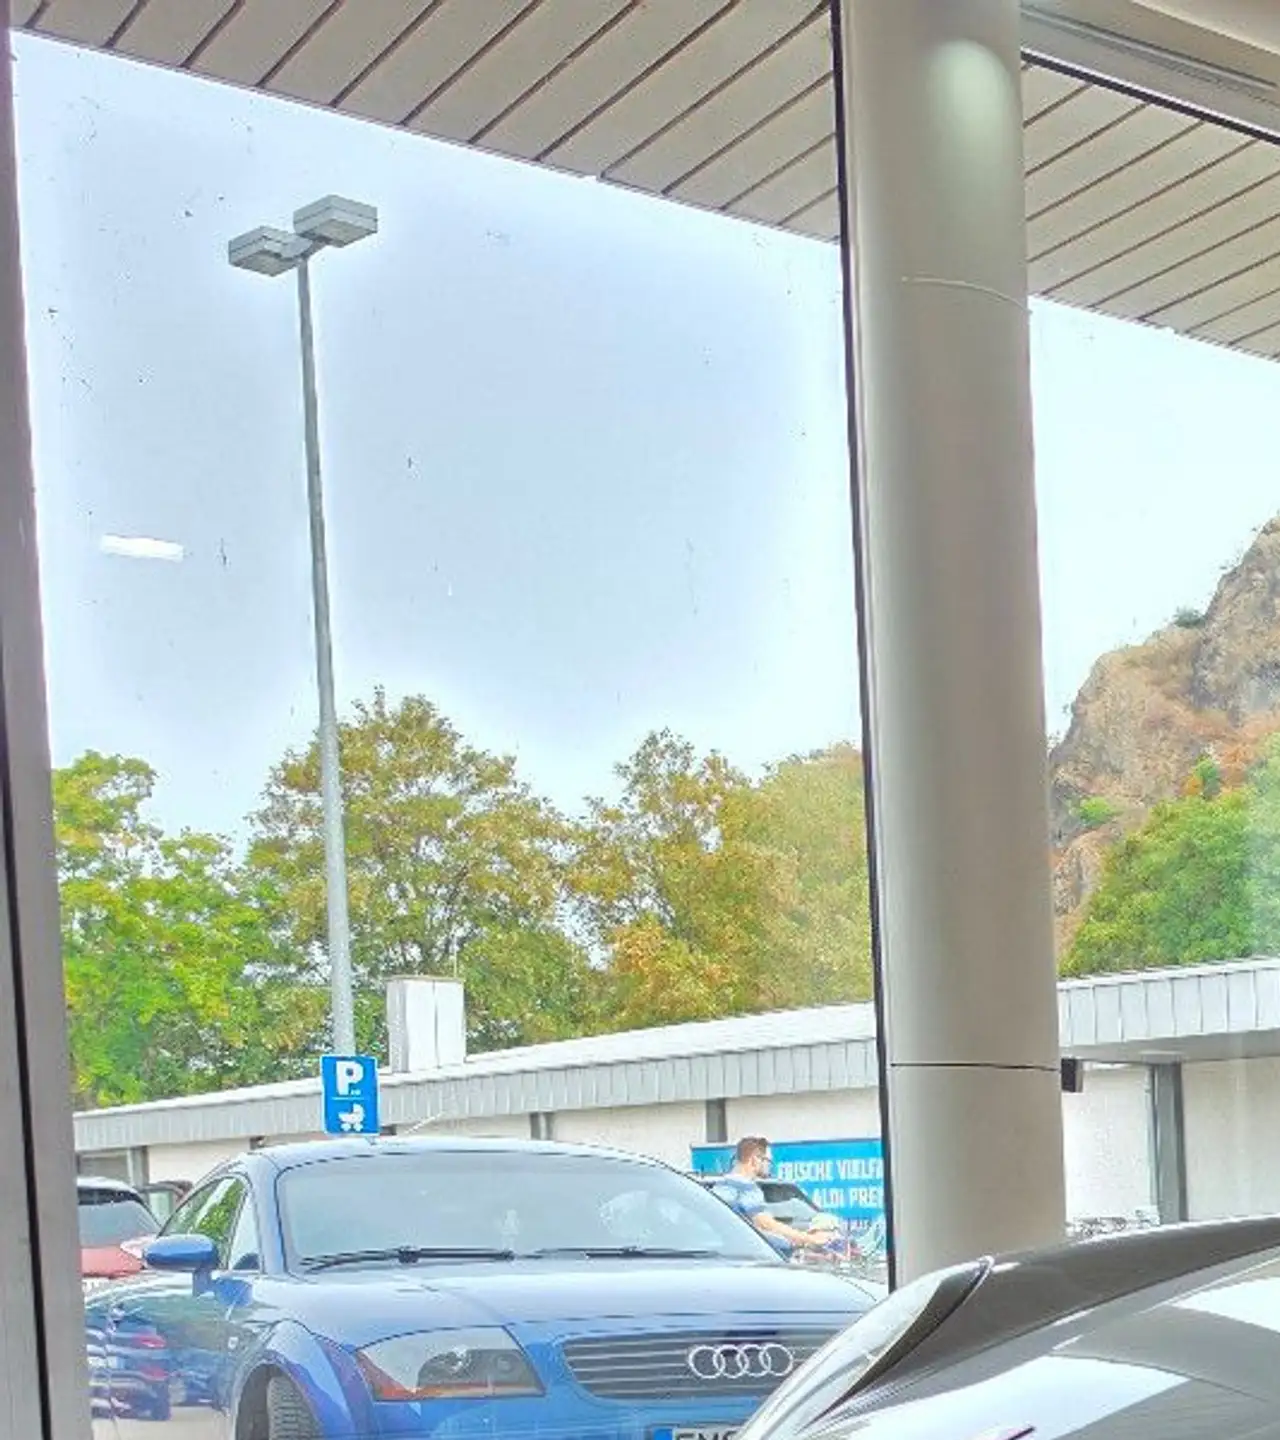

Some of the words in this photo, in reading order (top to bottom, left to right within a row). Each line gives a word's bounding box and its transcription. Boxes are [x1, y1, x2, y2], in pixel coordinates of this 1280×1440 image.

[335, 1060, 364, 1096] P
[777, 1160, 833, 1183] FRISCHE
[812, 1188, 843, 1209] ALDI
